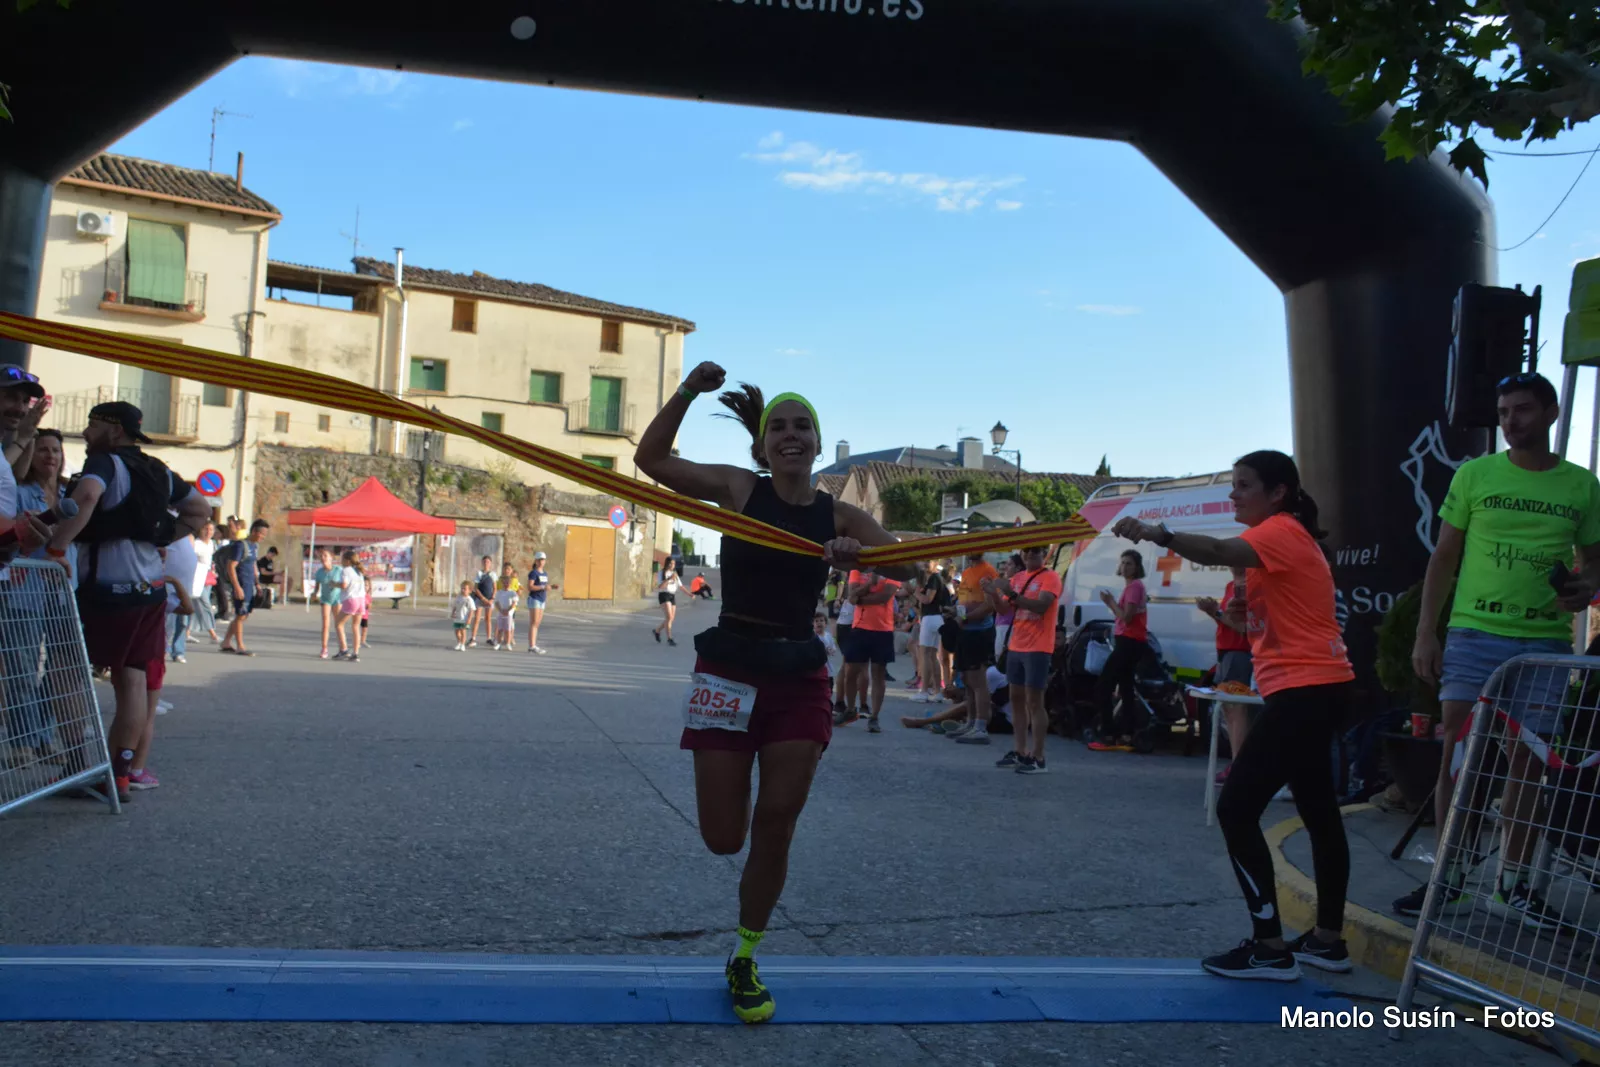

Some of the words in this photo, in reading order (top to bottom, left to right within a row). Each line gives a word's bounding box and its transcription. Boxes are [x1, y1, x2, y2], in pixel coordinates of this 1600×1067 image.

[1137, 503, 1201, 520] AMBULANCIA
[1483, 496, 1581, 521] ORGANIZACIÓN
[1336, 544, 1380, 566] vive!
[688, 688, 741, 712] 2054
[689, 707, 703, 715] ANA
